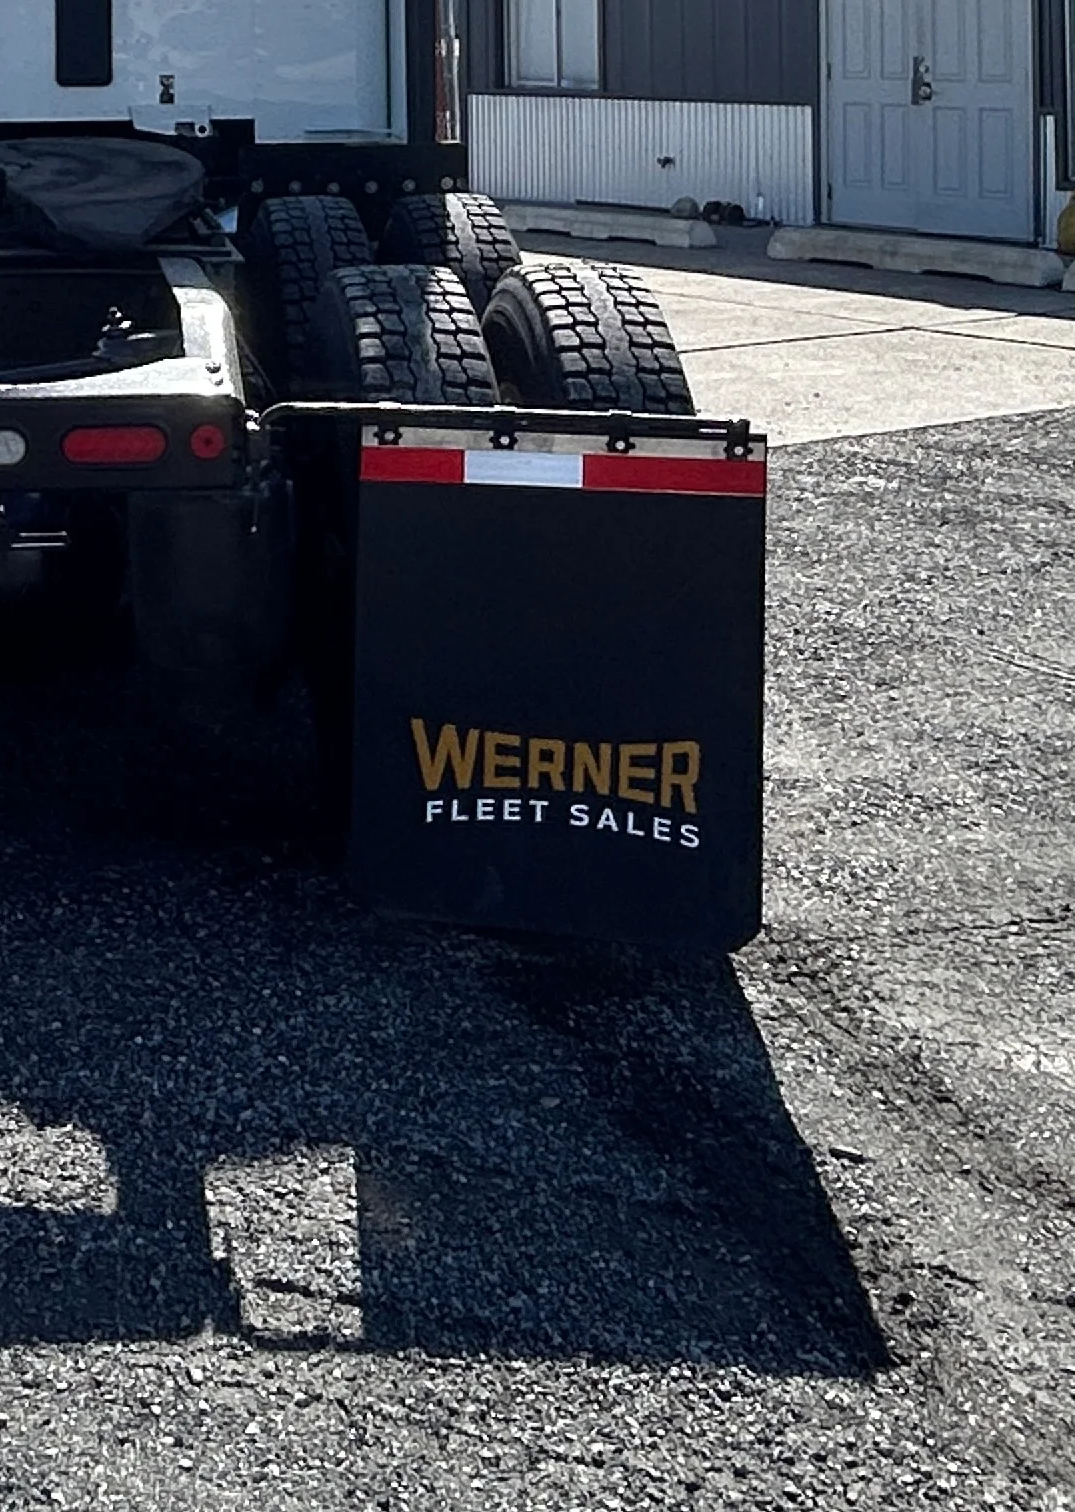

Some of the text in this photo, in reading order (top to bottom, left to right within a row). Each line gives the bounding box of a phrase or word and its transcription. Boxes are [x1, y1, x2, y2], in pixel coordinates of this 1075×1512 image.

[411, 718, 701, 814] WERNER
[425, 798, 700, 848] FLEET SALES
